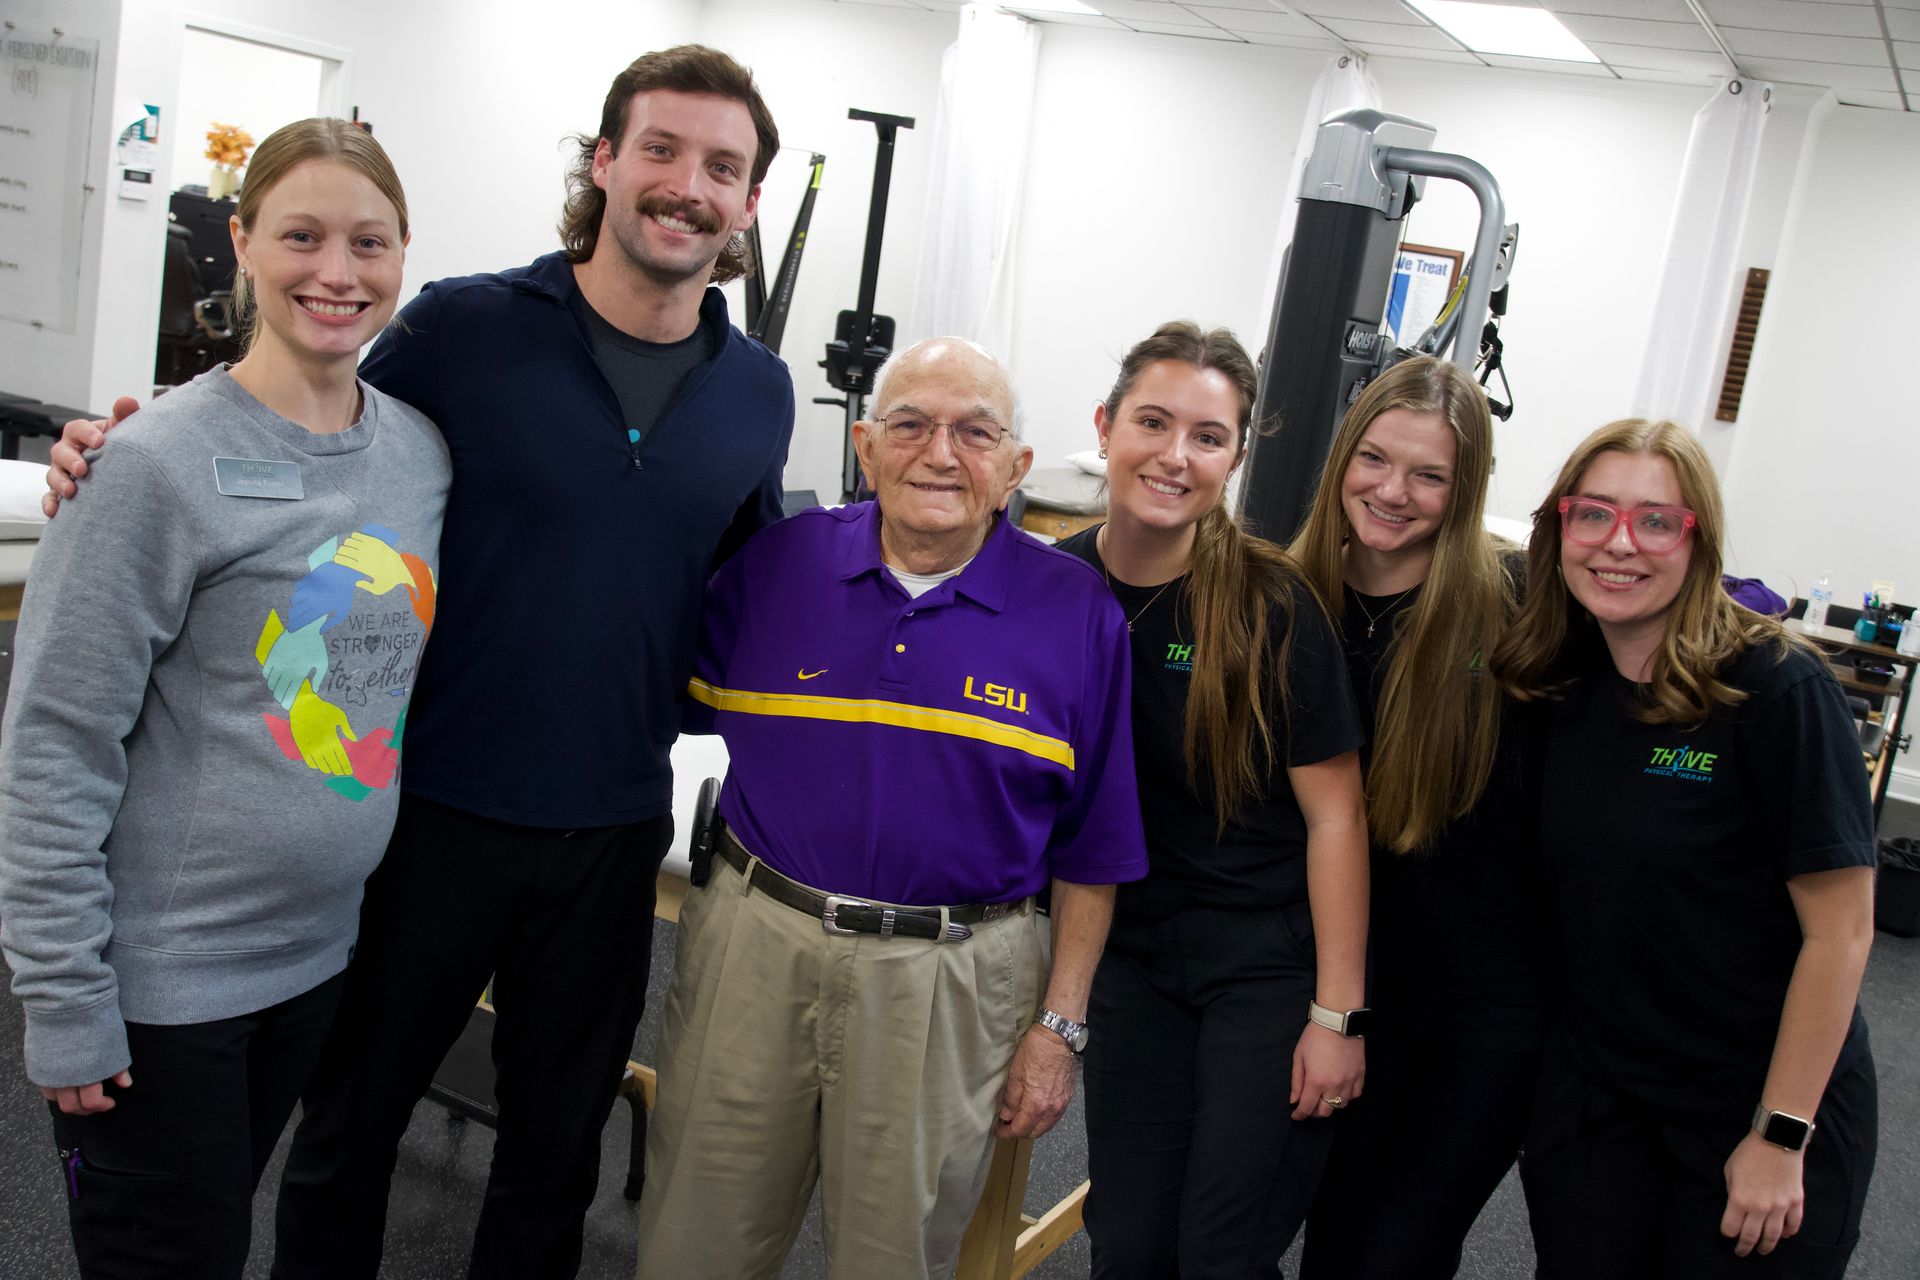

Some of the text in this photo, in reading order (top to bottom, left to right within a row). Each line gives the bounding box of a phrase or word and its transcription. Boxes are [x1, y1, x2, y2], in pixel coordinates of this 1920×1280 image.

[1417, 259, 1448, 276] Treat
[1347, 330, 1378, 350] HOIST
[348, 611, 410, 631] WE ARE
[963, 675, 1027, 713] LSU
[1643, 767, 1713, 782] PHYSICAL THERAPY
